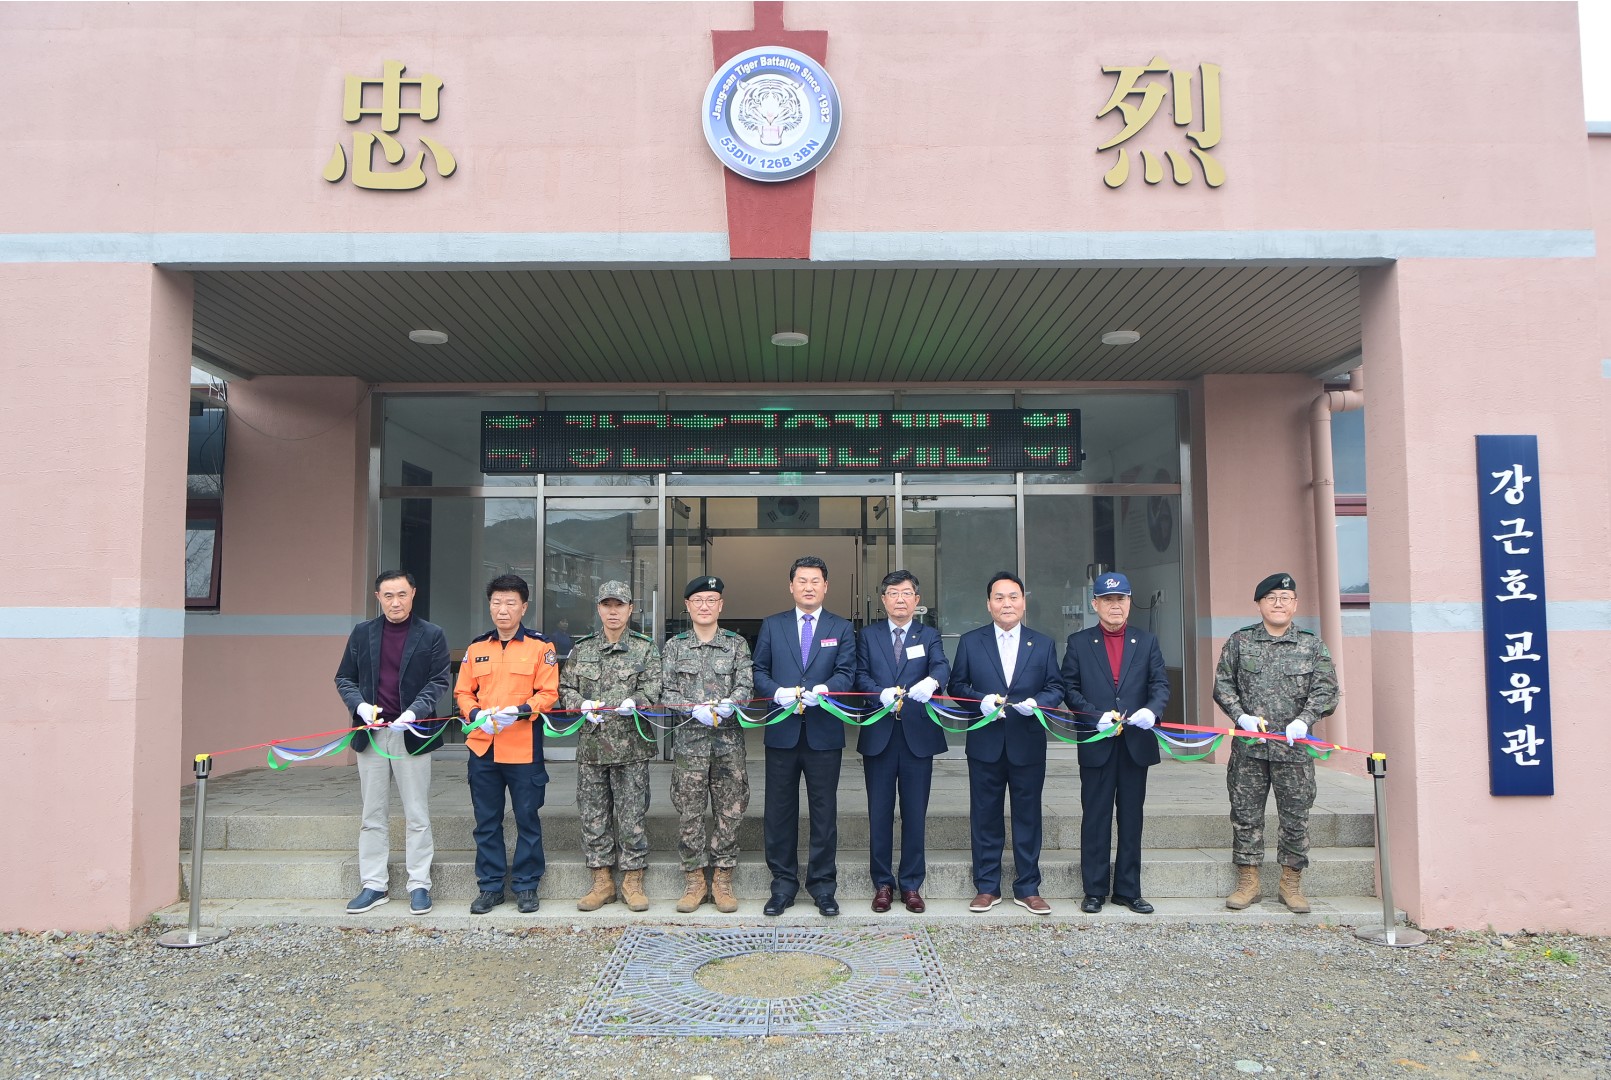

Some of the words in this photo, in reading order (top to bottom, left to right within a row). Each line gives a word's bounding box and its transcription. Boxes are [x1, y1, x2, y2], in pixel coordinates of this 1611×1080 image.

[322, 60, 457, 190] 忠
[712, 74, 737, 120] Jang-san
[734, 58, 759, 76] Tiger
[760, 56, 801, 73] Battalion
[800, 67, 821, 93] Since
[818, 93, 831, 124] 1982
[760, 157, 792, 169] 126B
[793, 139, 820, 162] 3BN
[1095, 56, 1226, 188] 烈
[1489, 463, 1538, 602] 강근호
[1499, 631, 1545, 766] 교육관
